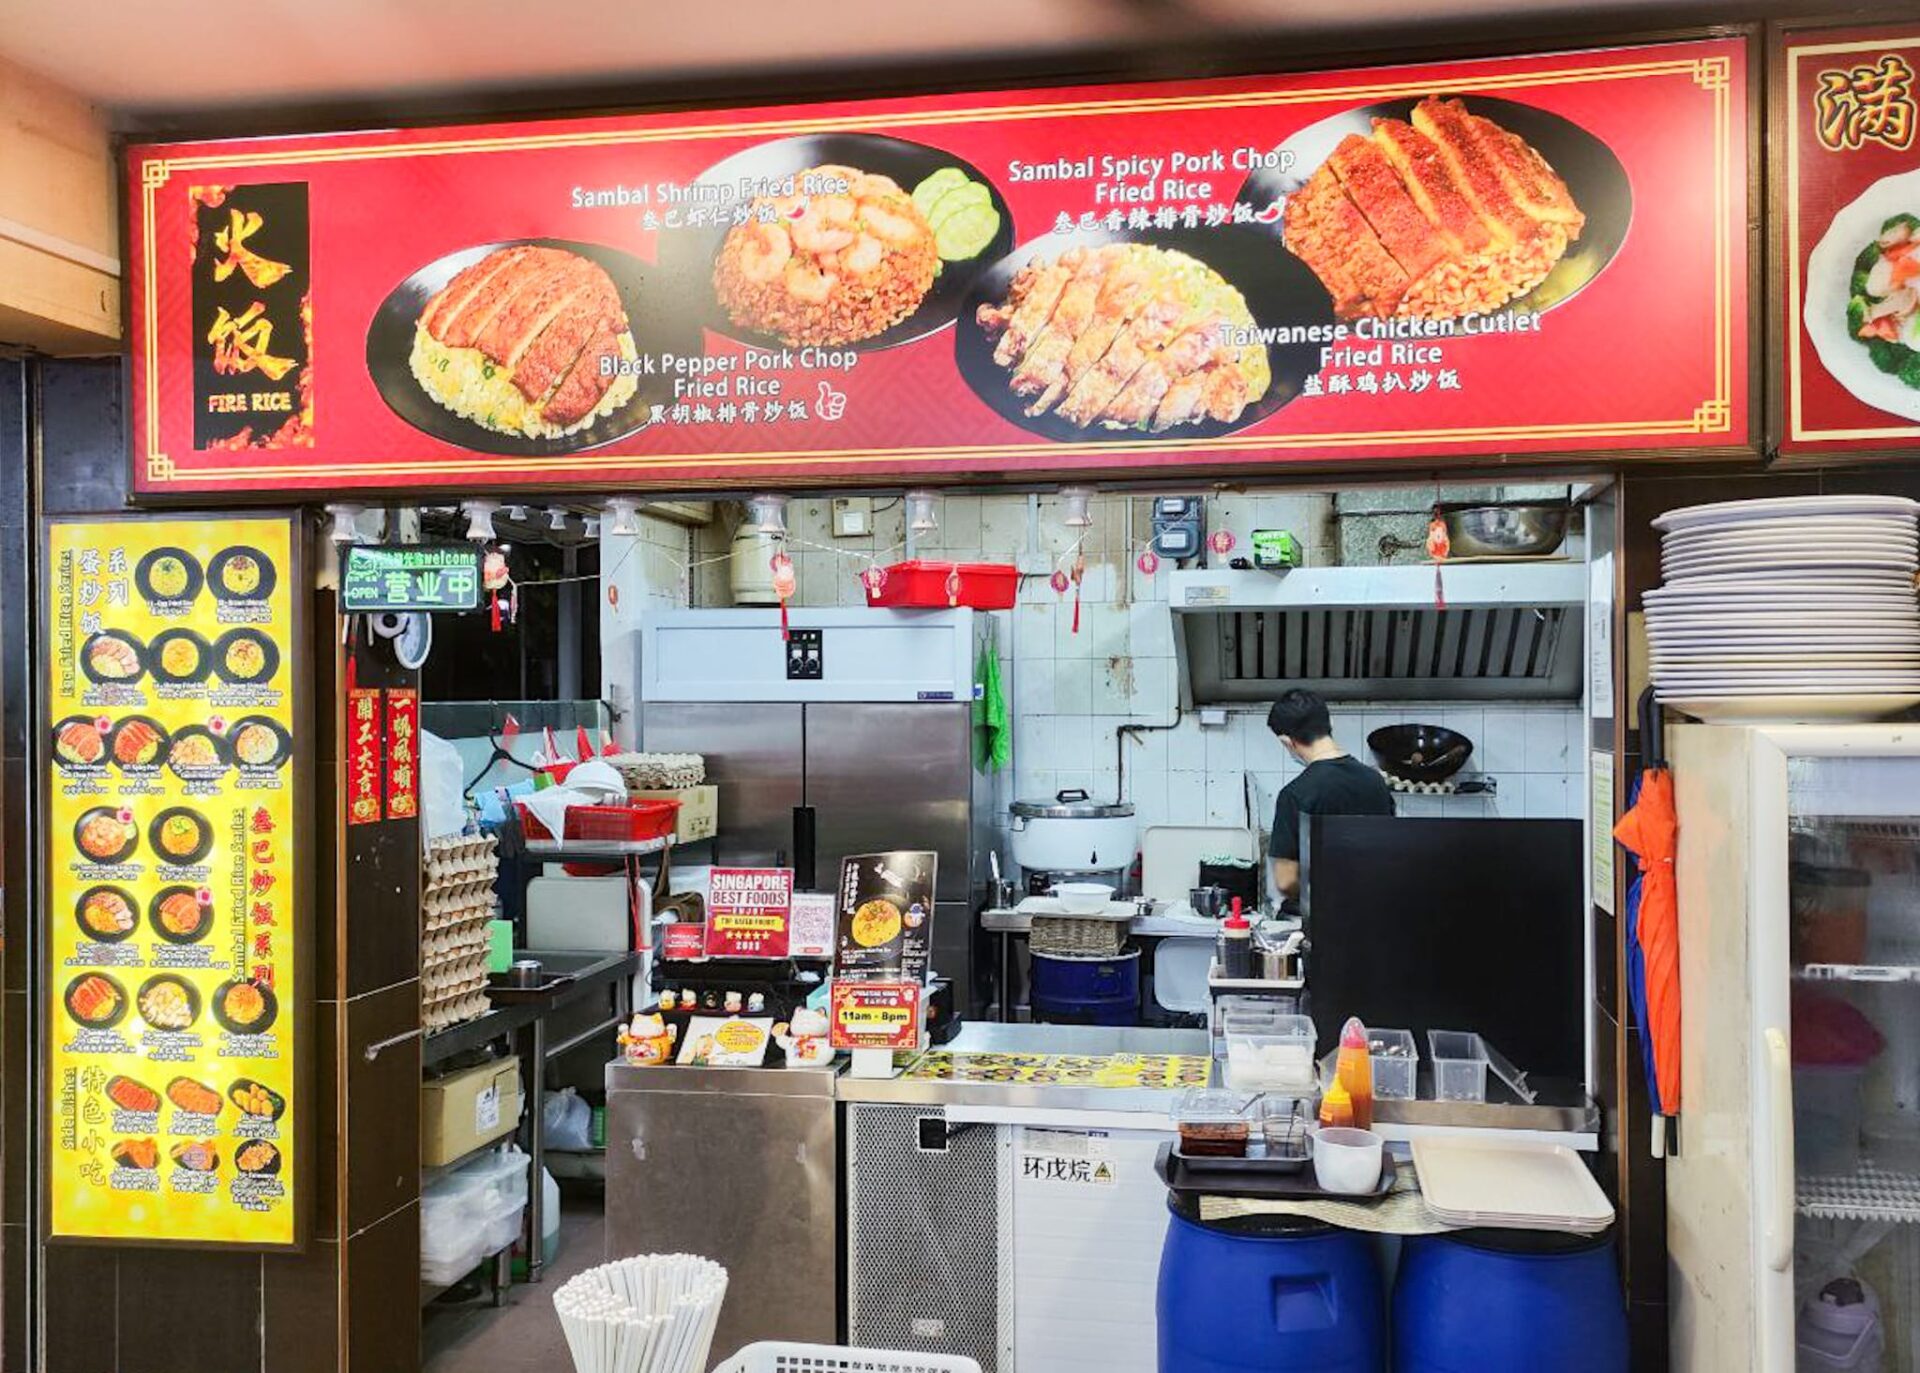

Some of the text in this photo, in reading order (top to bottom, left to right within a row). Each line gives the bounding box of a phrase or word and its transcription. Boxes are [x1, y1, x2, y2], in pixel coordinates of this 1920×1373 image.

[1815, 54, 1917, 151] 满
[1008, 147, 1295, 182] Sambal Spicy Pork Chop
[571, 174, 849, 207] Sambal Shrimp Fried Rice
[1095, 178, 1212, 203] Fried Rice
[207, 208, 299, 381] 火饭
[1220, 311, 1541, 346] Taiwanese Chicken Cutlet
[600, 346, 858, 378] Black Pepper Pork Chop
[1319, 343, 1443, 368] Fried Rice
[673, 376, 781, 398] Fried Rice
[1301, 368, 1462, 397] 盐酥鸡扒炒饭
[208, 392, 292, 413] FIRE RICE
[649, 400, 809, 424] 黑胡椒排骨炒饭
[351, 587, 379, 599] OPEN
[385, 571, 473, 604] 营业中
[59, 596, 72, 629] Rice
[712, 874, 789, 891] SINGAPORE
[712, 891, 785, 905] BEST FOODS
[230, 887, 245, 926] Fried
[230, 930, 245, 983] Sambal
[841, 1011, 872, 1021] 11am
[882, 1010, 908, 1023] 8pm
[61, 1067, 75, 1150] Side Dishes
